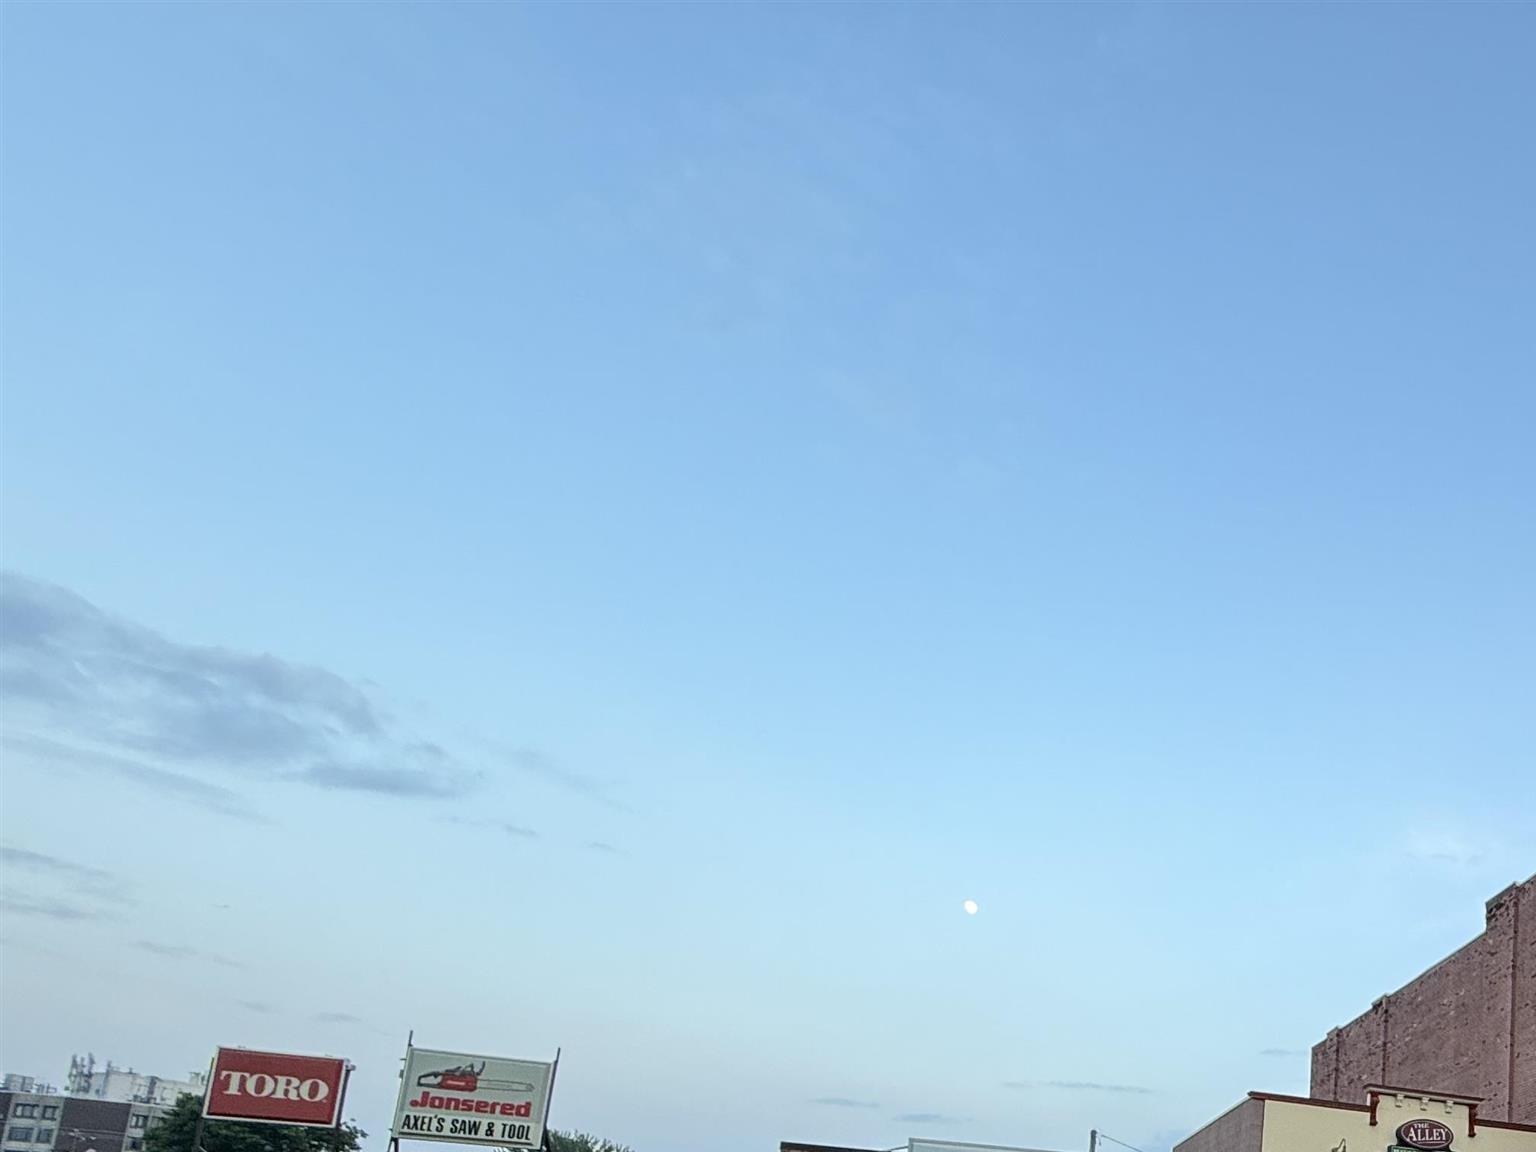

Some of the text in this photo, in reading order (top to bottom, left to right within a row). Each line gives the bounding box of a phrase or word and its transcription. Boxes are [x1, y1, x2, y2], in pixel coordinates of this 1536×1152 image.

[220, 1070, 329, 1102] TORO
[409, 1091, 531, 1117] Jonsered
[402, 1114, 531, 1140] AXEL'S SAW & TOOL
[1408, 1127, 1448, 1142] ALLEY
